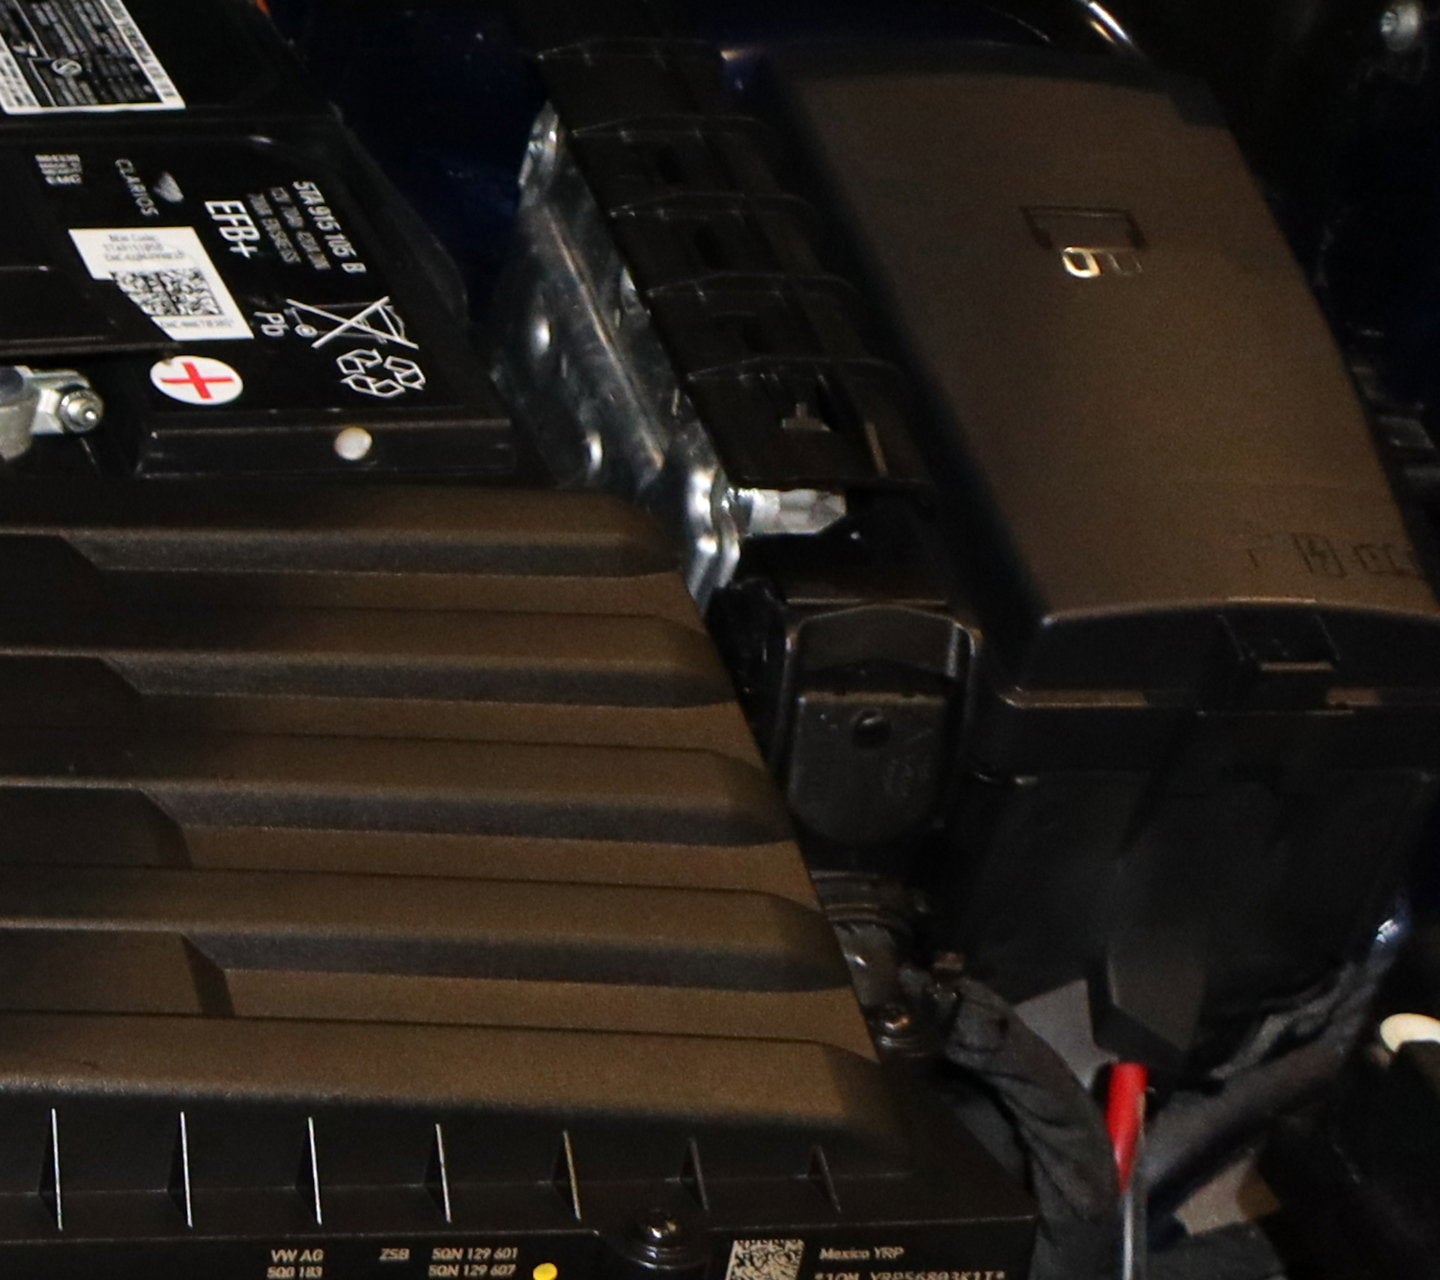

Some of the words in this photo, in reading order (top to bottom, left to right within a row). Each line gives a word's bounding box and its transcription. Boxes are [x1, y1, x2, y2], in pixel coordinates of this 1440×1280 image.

[114, 158, 160, 217] CLARIOS
[307, 206, 341, 231] 915
[204, 200, 261, 260] EFB+
[324, 234, 358, 258] 105
[340, 262, 367, 274] B
[253, 311, 290, 337] Pb
[271, 1249, 297, 1262] VW
[299, 1249, 324, 1261] AG
[379, 1248, 411, 1260] ZSB
[466, 1247, 491, 1260] 129
[493, 1247, 518, 1259] 601
[818, 1248, 870, 1261] Mexico
[873, 1246, 905, 1260] YRP
[463, 1264, 488, 1276] 129
[490, 1264, 516, 1276] 607
